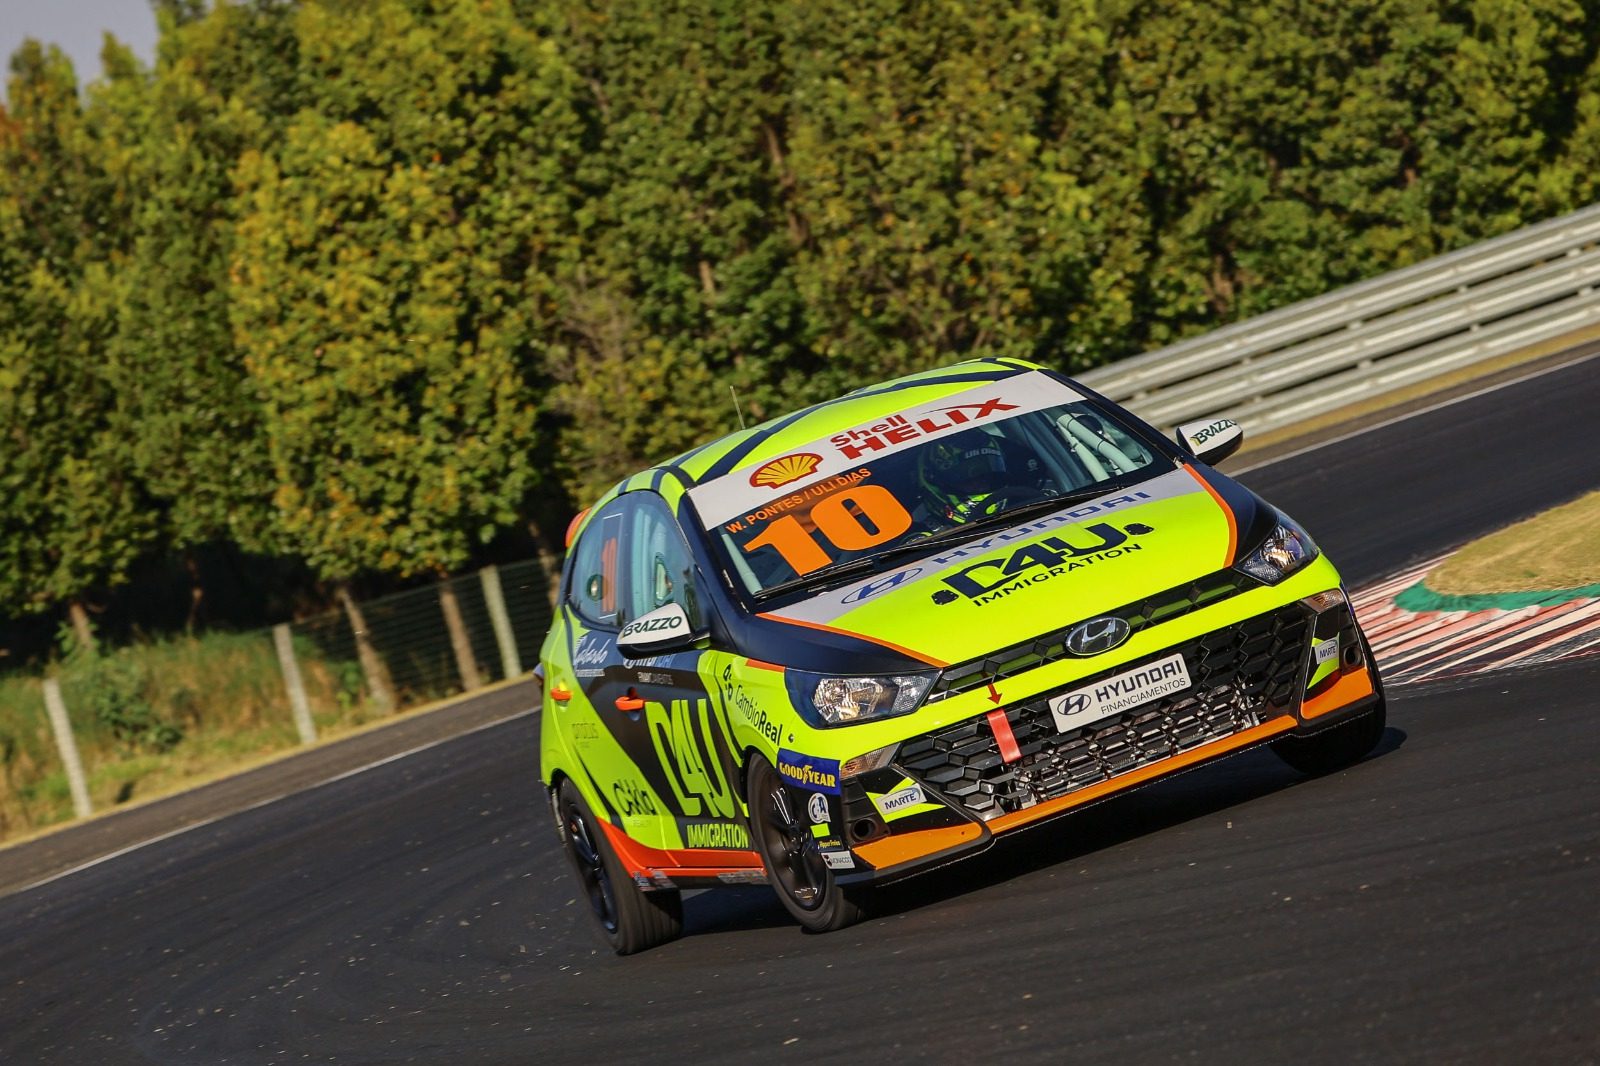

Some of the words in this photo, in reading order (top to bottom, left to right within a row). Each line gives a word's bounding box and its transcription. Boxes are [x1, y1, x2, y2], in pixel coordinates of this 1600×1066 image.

[830, 415, 910, 447] Shell
[835, 397, 1020, 460] HELIX
[725, 518, 743, 534] W.
[746, 495, 804, 526] PONTES
[811, 480, 834, 498] ULI
[834, 467, 873, 488] DIAS
[743, 484, 913, 577] 10
[932, 491, 1152, 564] HYUNDAI
[972, 543, 1143, 607] IMMIGRATION
[623, 615, 682, 637] BRAZZO
[1319, 646, 1337, 659] MARTE
[1095, 660, 1182, 703] HYUNDAI
[1100, 678, 1187, 715] FINANCIAMENTOS
[736, 684, 783, 746] CambioReal
[779, 761, 836, 788] GOODYEAR
[884, 794, 917, 810] MARTE
[686, 823, 749, 849] IMMIGRATION
